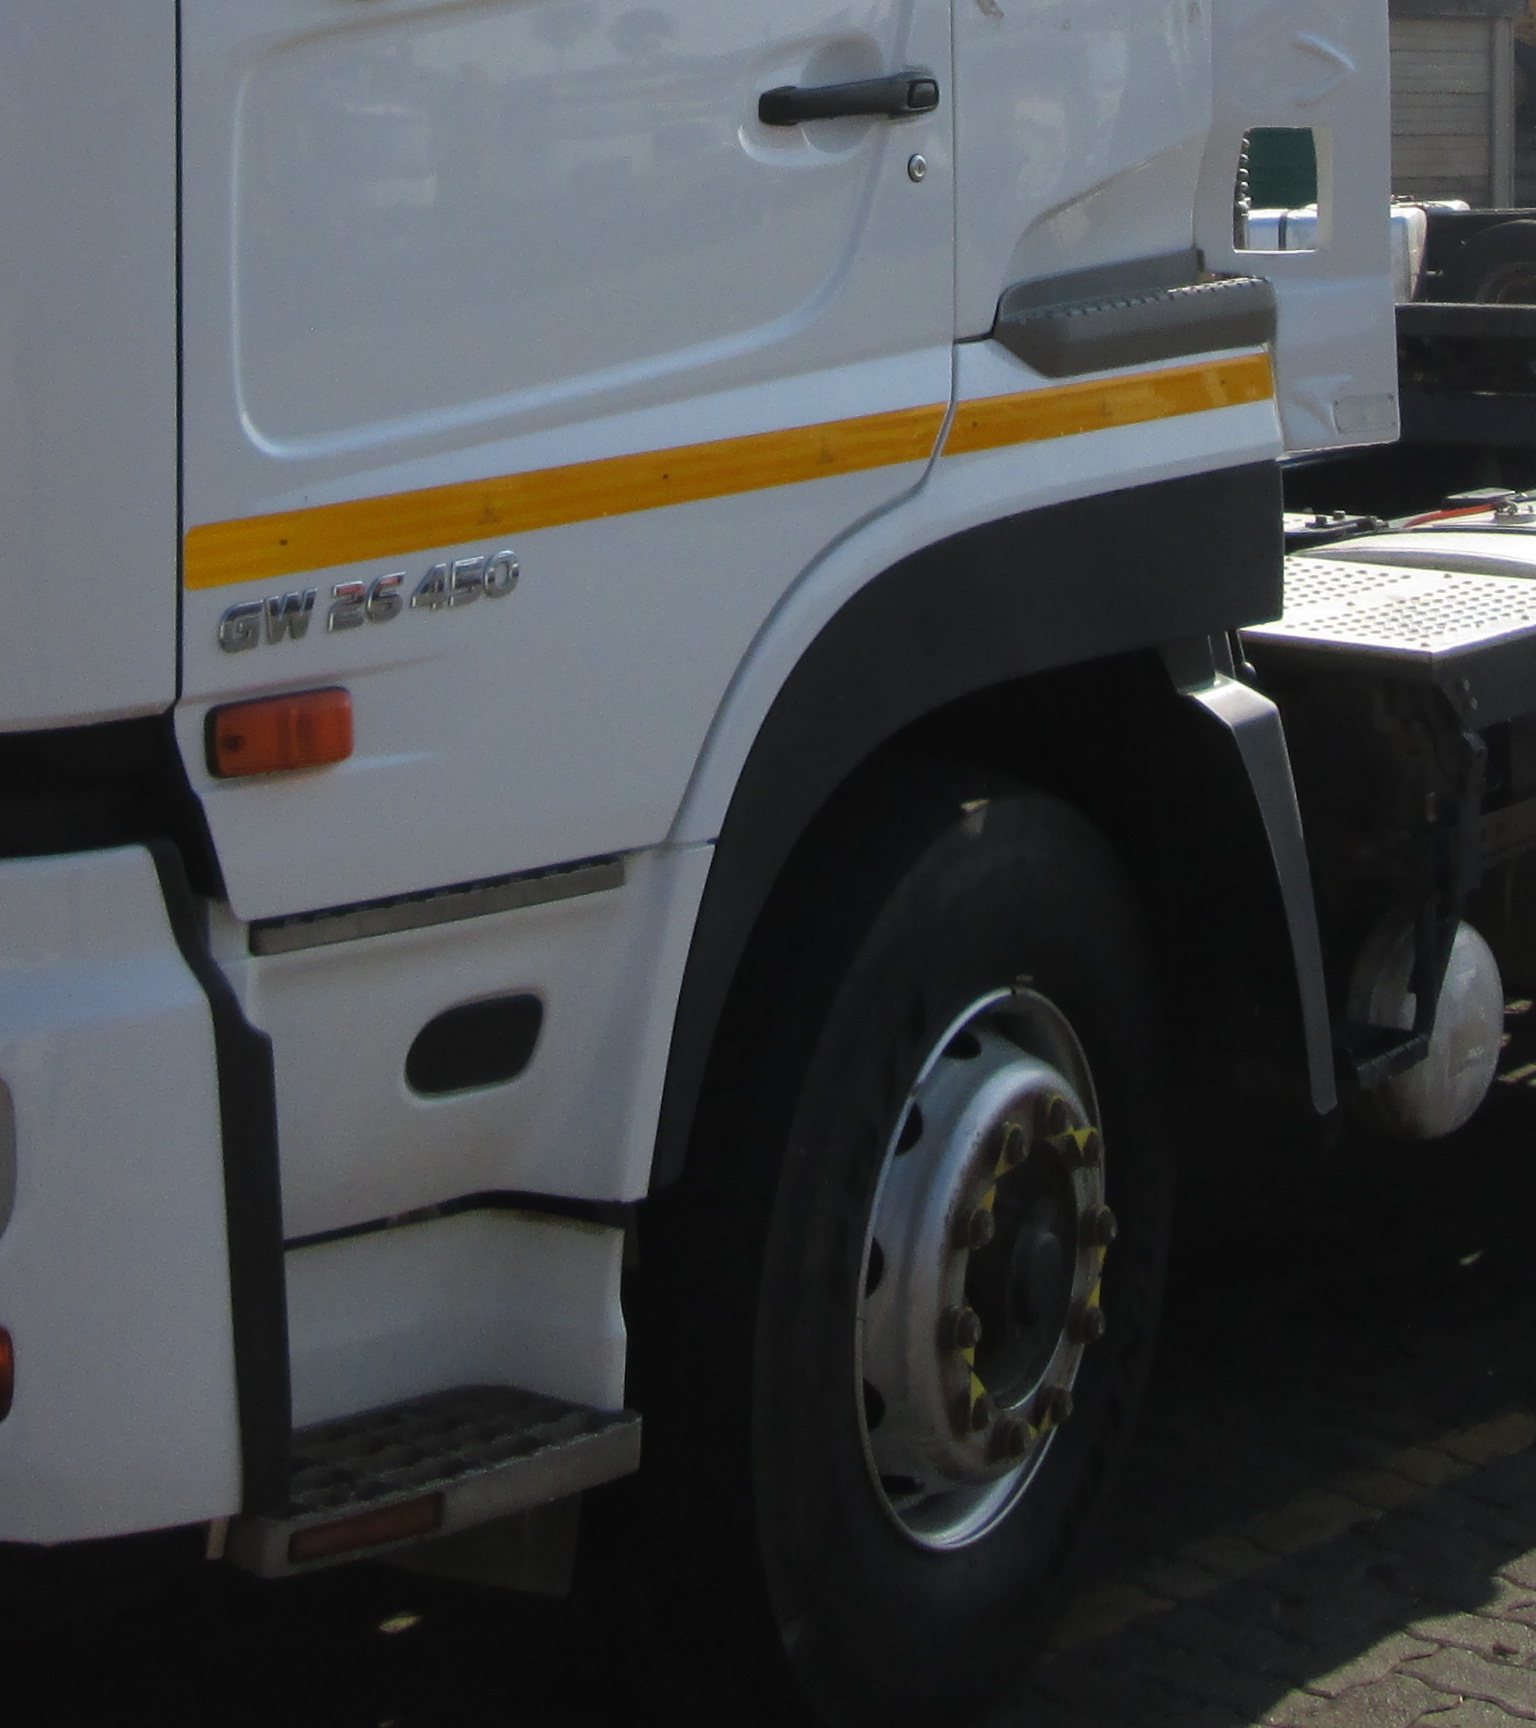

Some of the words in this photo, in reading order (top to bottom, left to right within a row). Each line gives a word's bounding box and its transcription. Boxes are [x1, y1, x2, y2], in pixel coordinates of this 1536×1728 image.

[218, 587, 319, 654] GW
[326, 571, 407, 633] 26
[410, 549, 522, 610] 450
